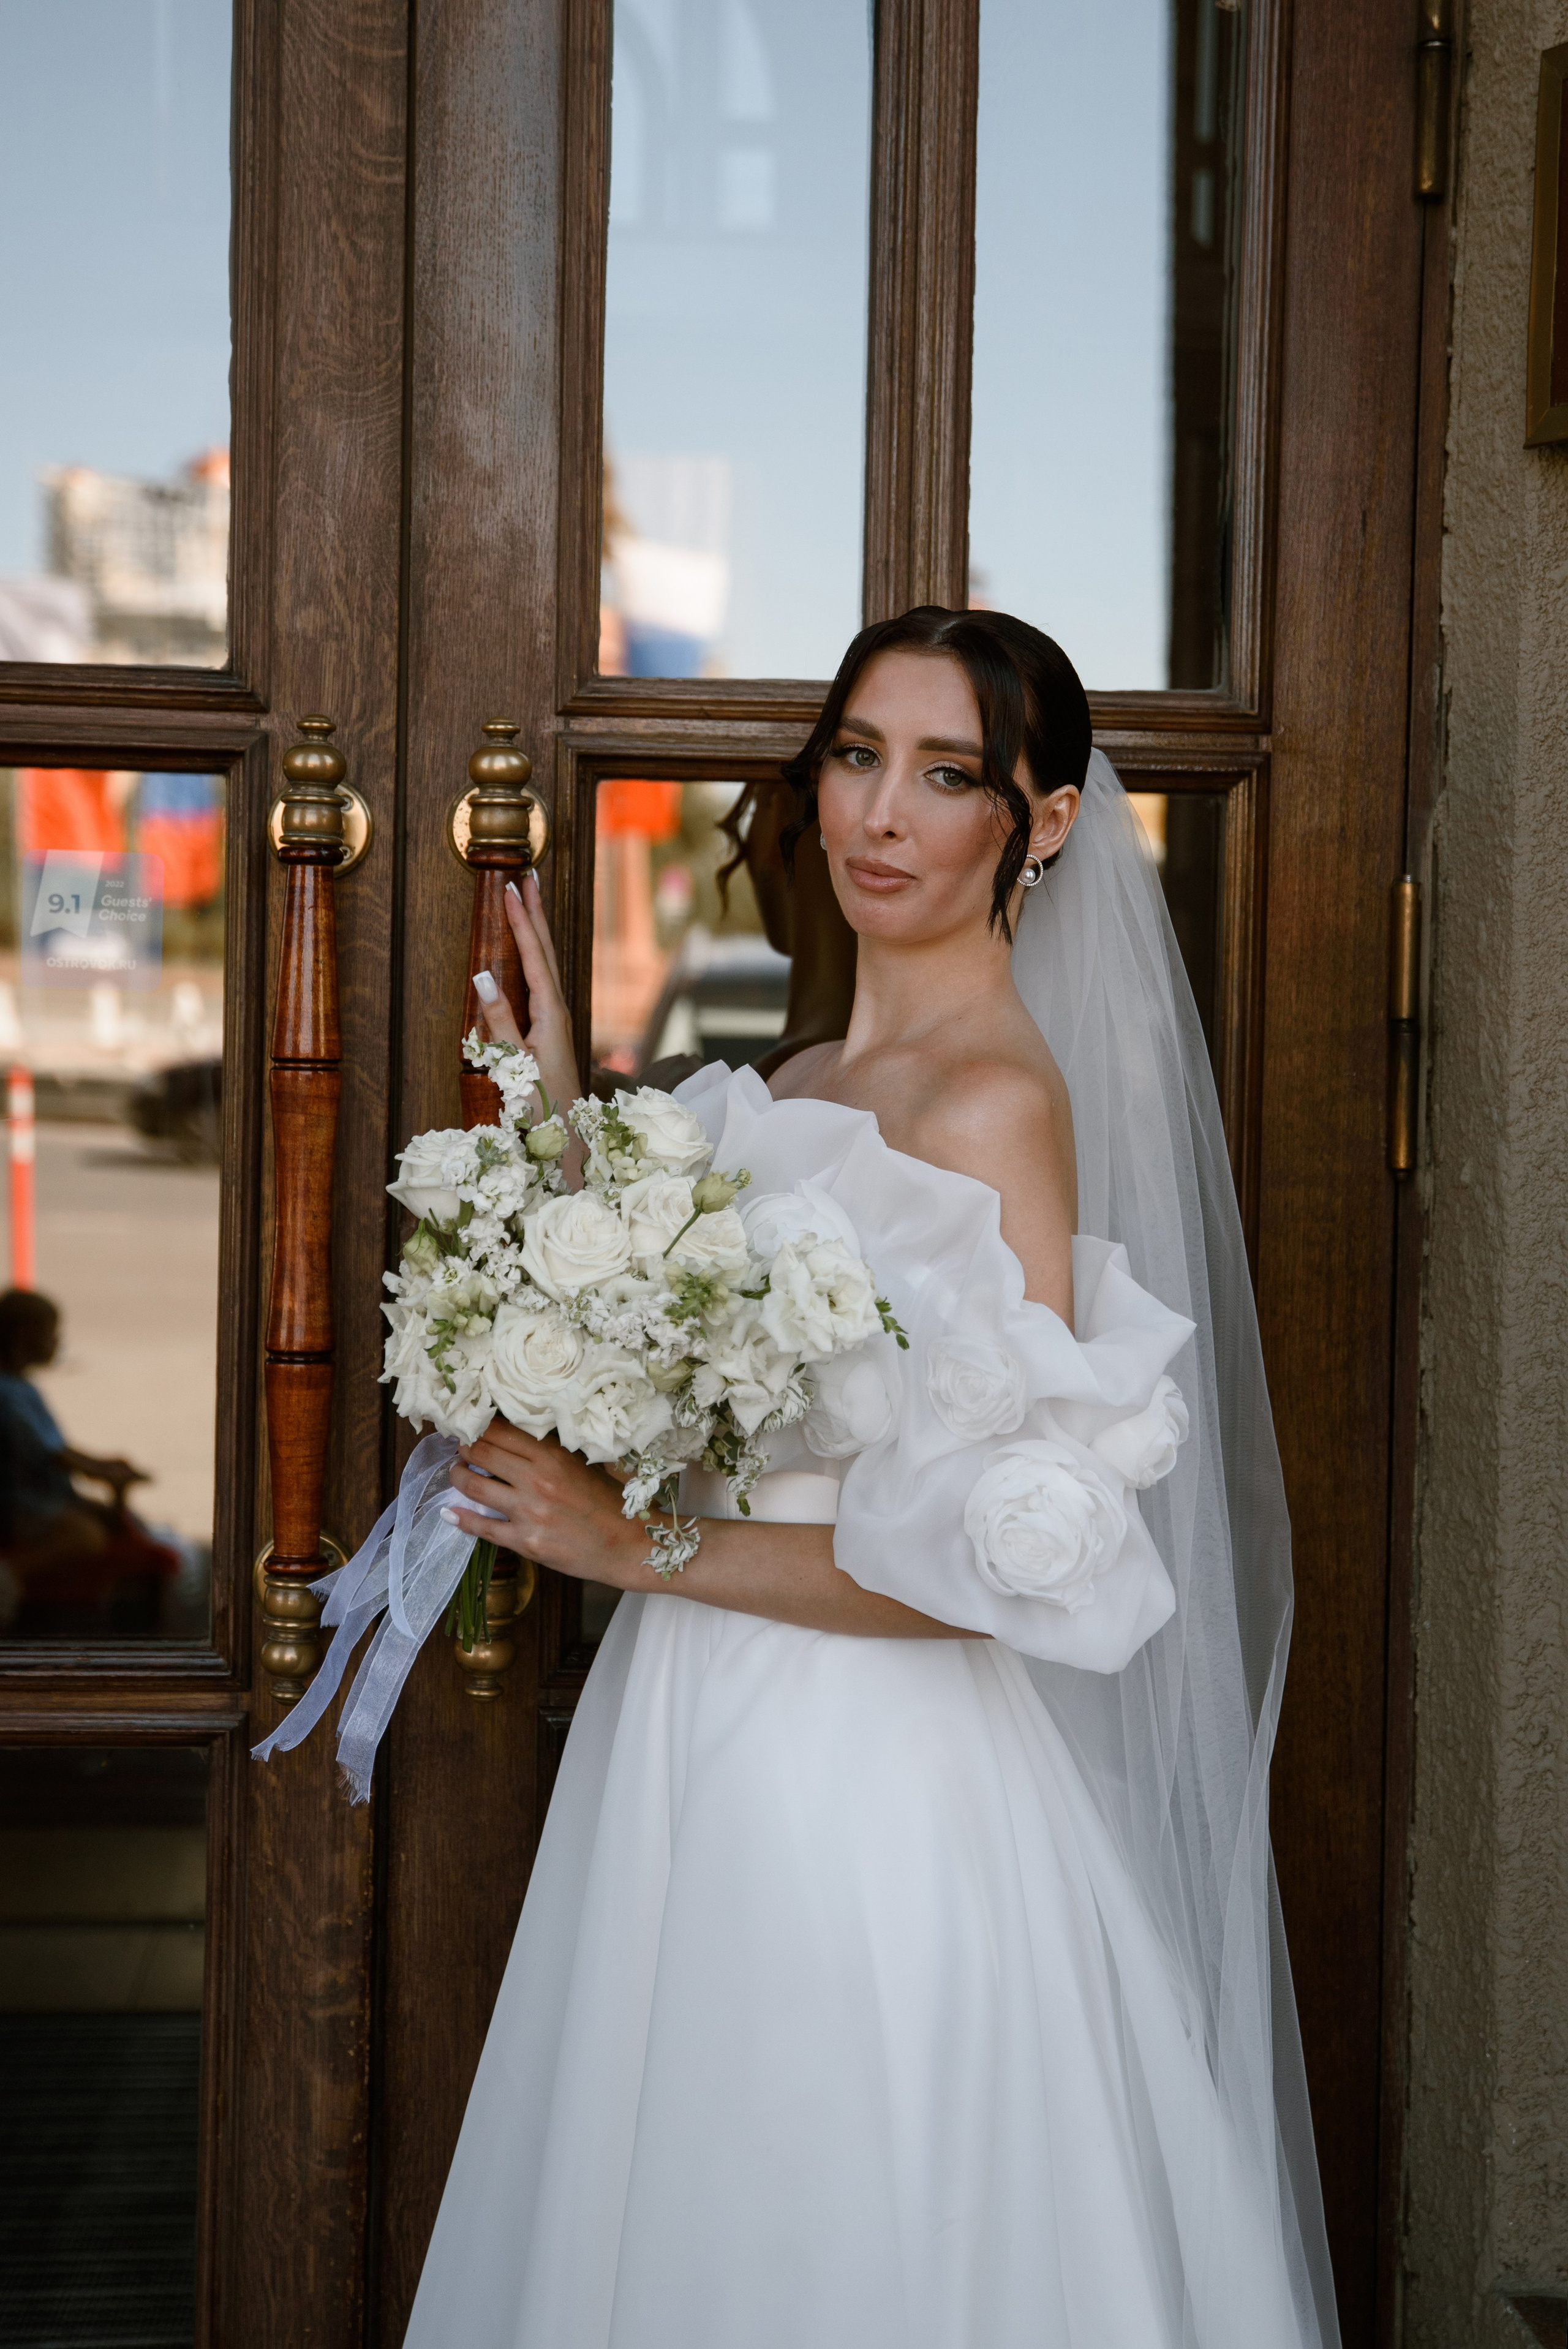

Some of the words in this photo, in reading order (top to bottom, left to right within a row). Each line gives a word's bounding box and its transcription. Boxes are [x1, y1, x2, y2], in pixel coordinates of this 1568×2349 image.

[48, 893, 80, 914] 9.1
[99, 909, 146, 921] Choice
[47, 957, 136, 970] OSTROVOK.RU
